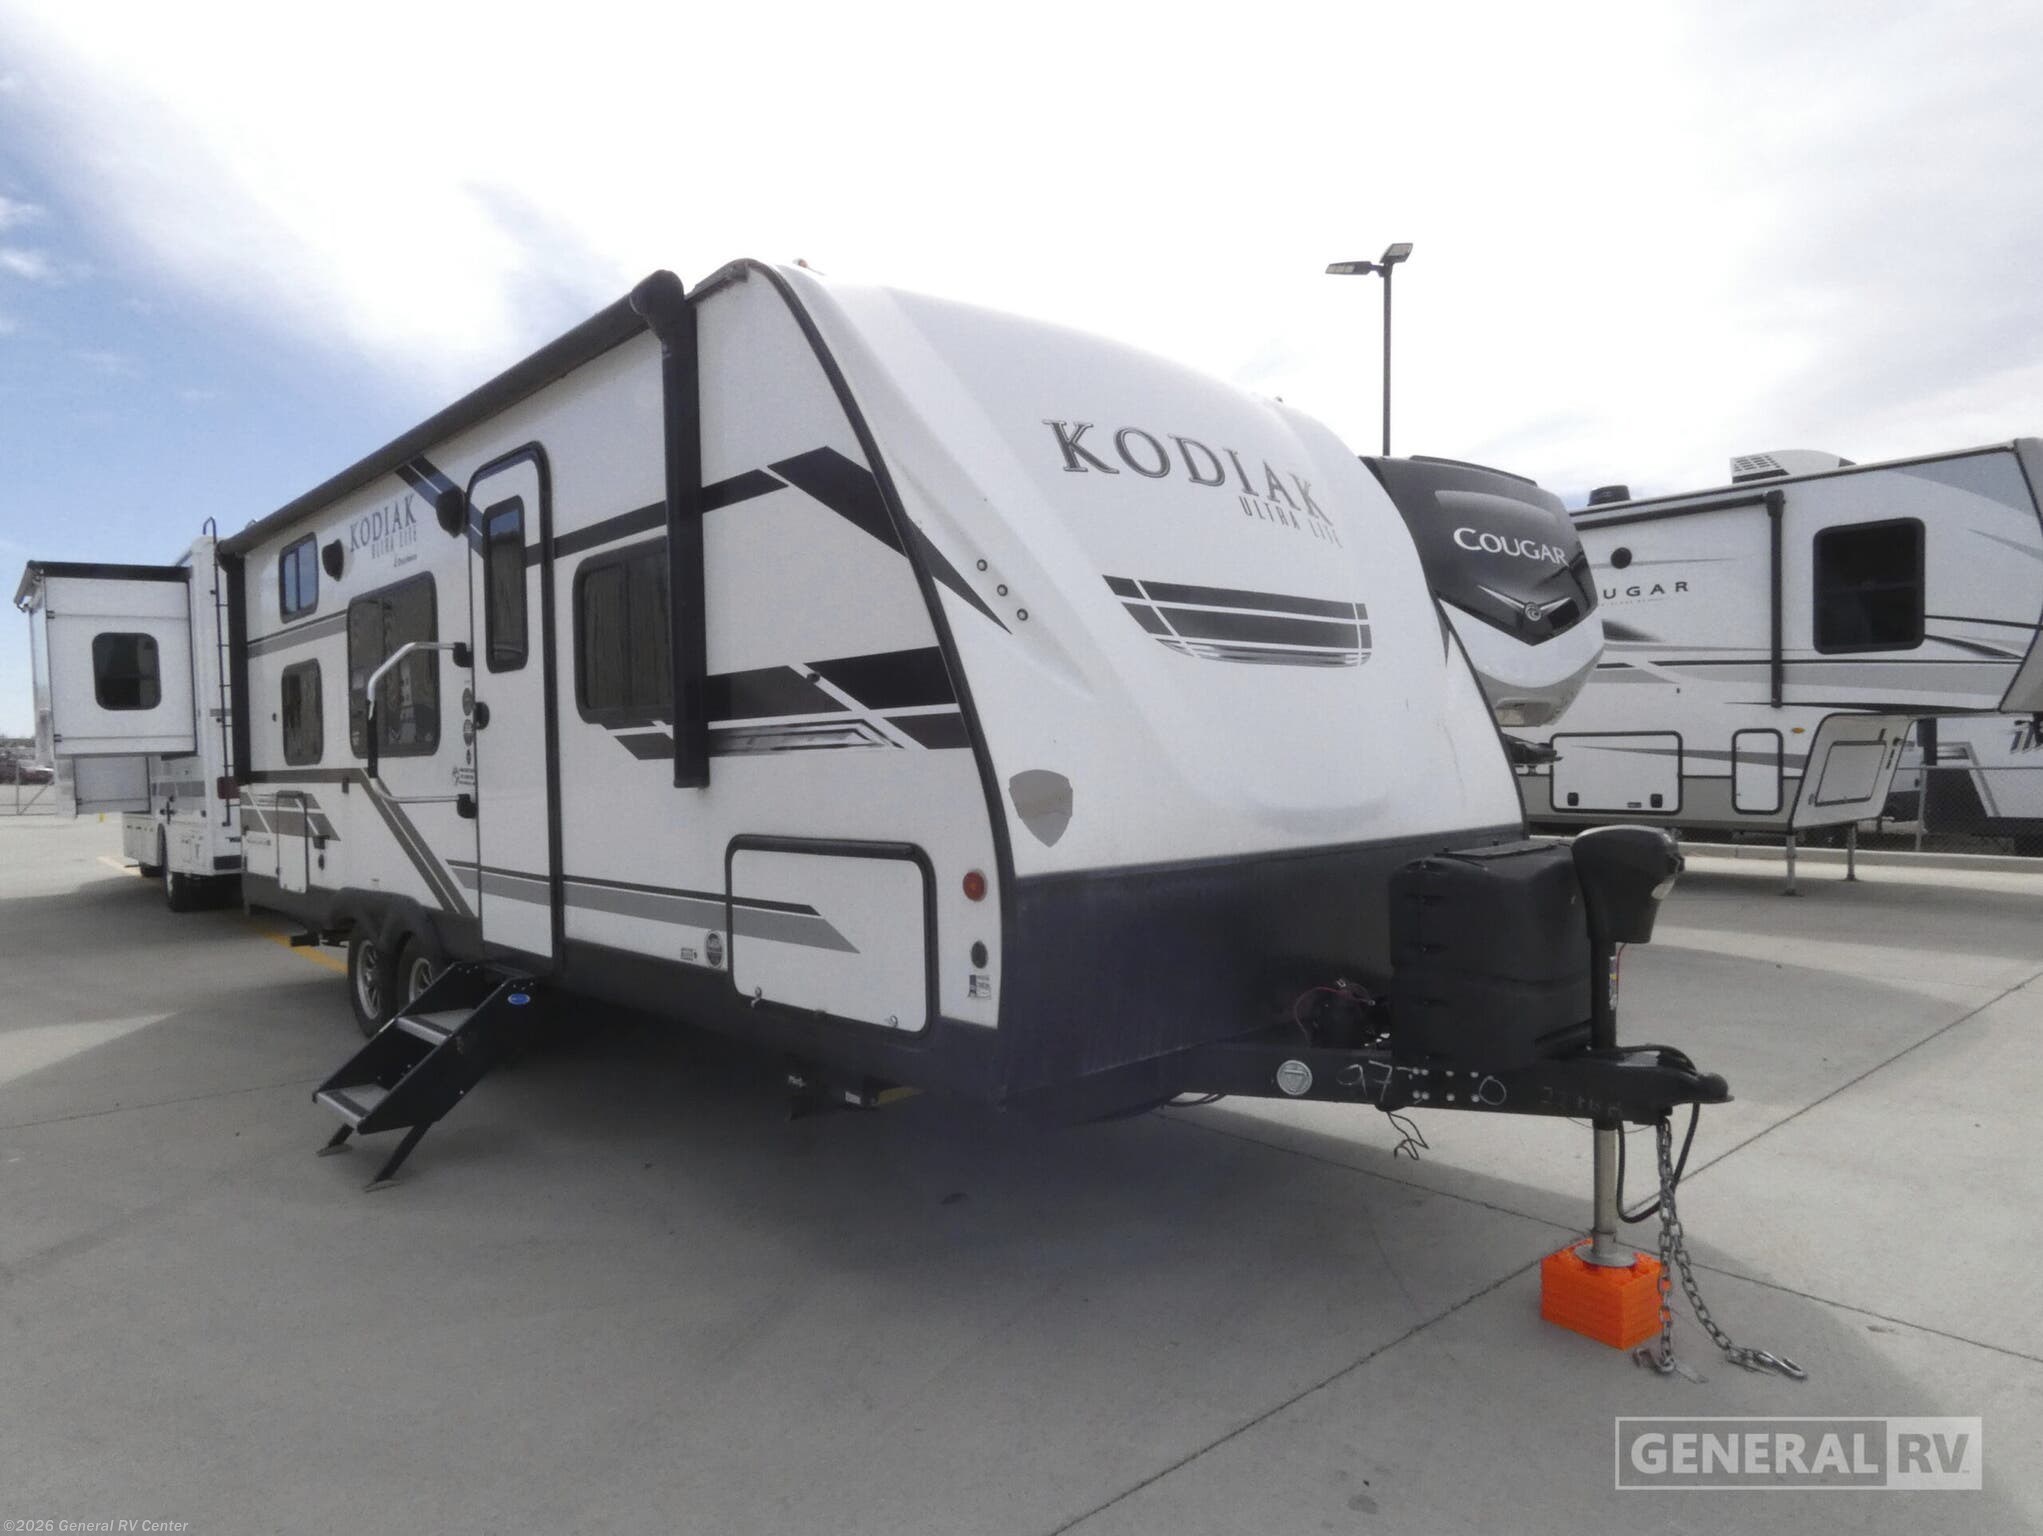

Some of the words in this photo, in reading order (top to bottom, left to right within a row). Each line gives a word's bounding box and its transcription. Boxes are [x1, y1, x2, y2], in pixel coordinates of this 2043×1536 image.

[1042, 418, 1334, 527] KODIAK
[349, 493, 417, 553] KODIAK
[1238, 495, 1301, 530] ULTRA
[1453, 527, 1570, 568] COUGAR
[1602, 580, 1689, 600] UGAR
